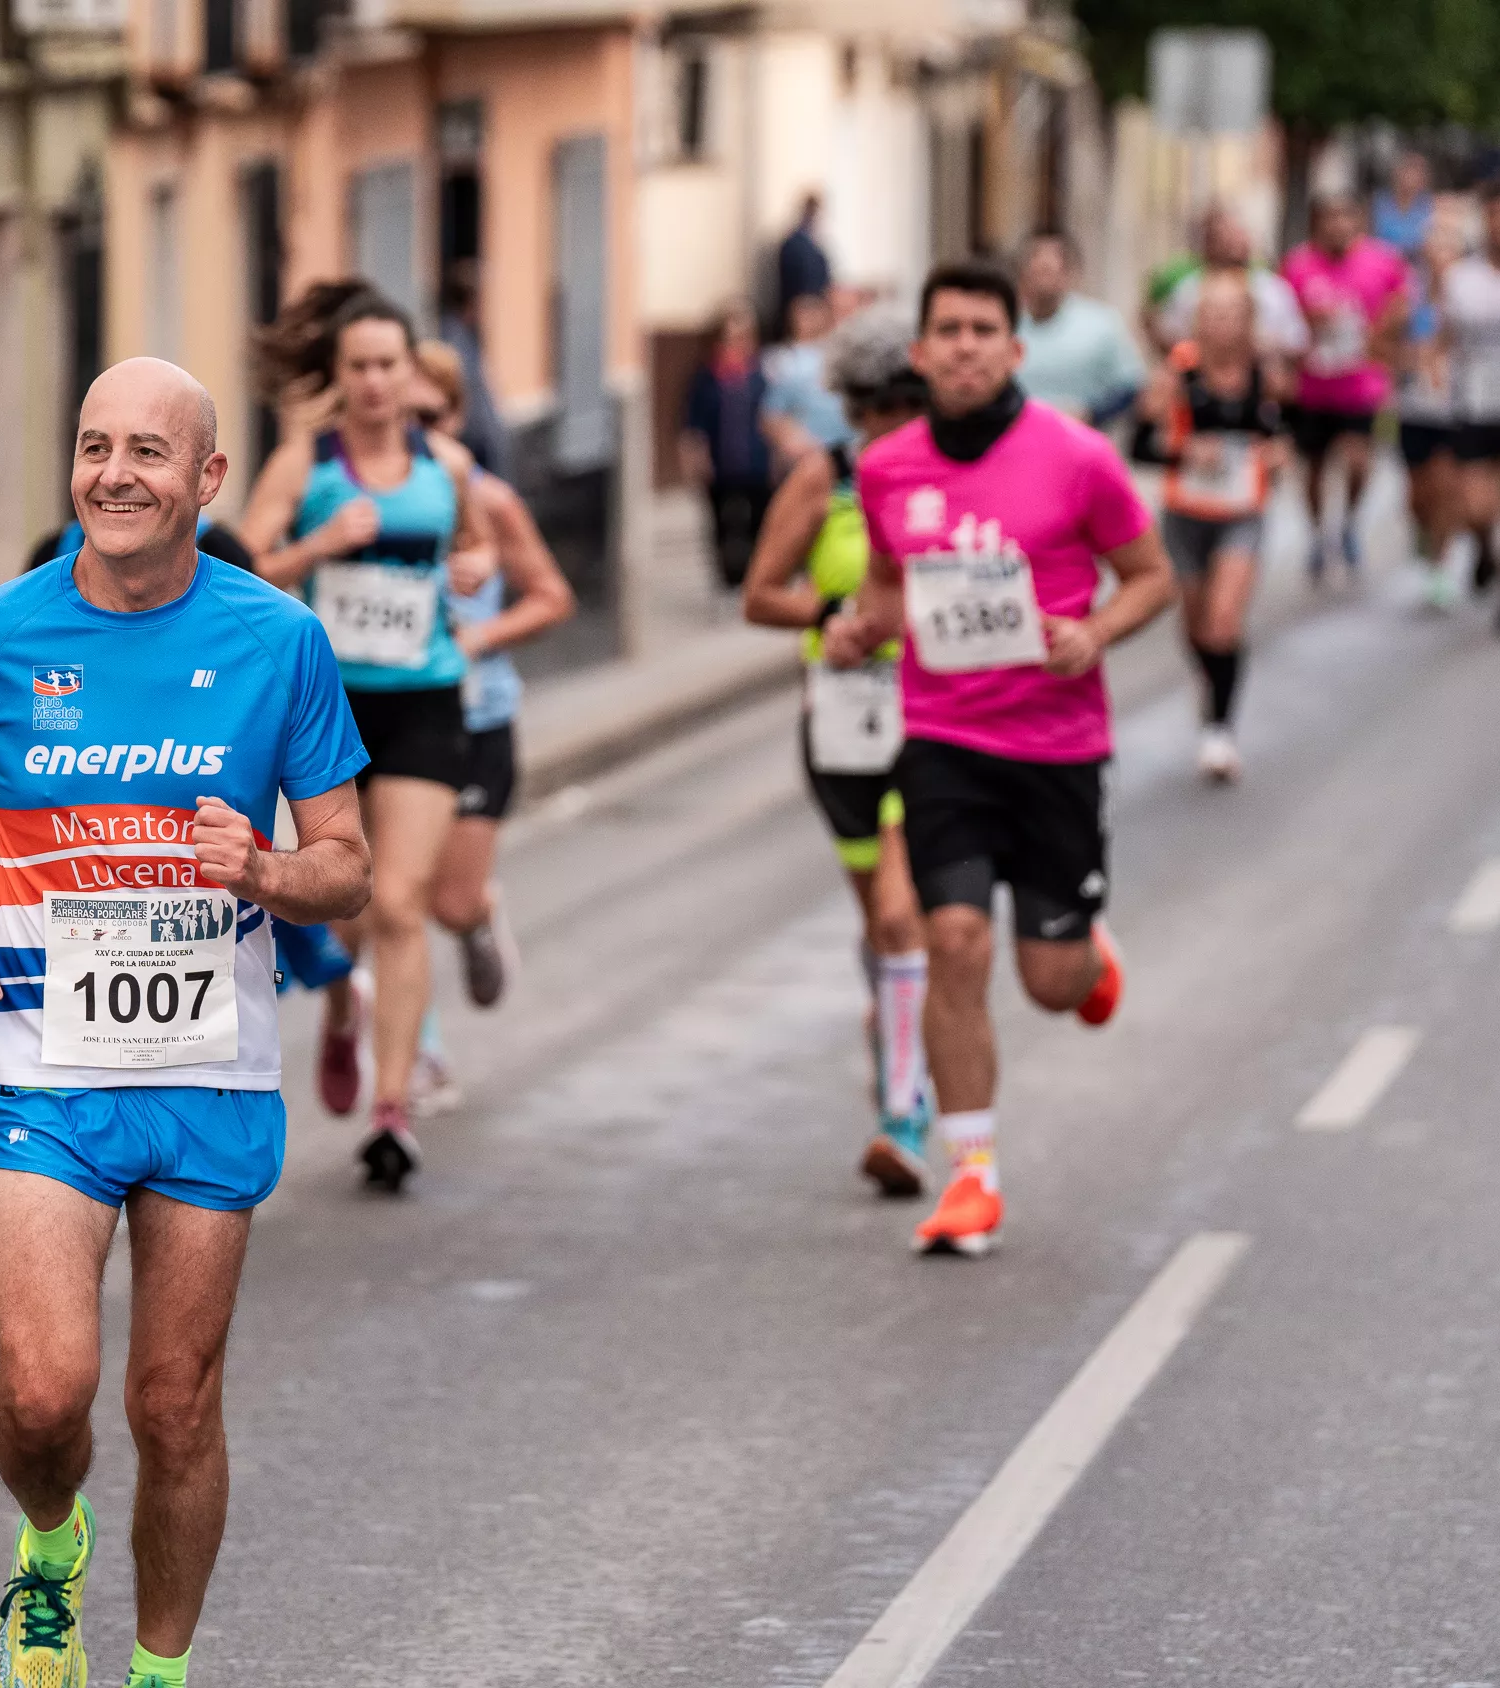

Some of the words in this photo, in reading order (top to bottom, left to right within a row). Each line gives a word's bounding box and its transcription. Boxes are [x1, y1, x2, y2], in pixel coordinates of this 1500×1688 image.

[33, 696, 62, 708] Club
[33, 706, 82, 719] Maratón
[33, 718, 79, 730] Lucena
[70, 859, 196, 889] Lucena
[51, 899, 86, 909] CIRCUITO
[87, 900, 135, 911] PROVINCIAL
[137, 901, 148, 911] DE
[150, 899, 200, 920] 2024
[50, 908, 95, 918] CARRERAS
[97, 909, 148, 919] POPULARES
[51, 917, 94, 926] DIPUTACIÓN
[111, 918, 149, 926] CÓRDOBA
[95, 949, 111, 957] XXV
[166, 949, 194, 957] LUCENA
[73, 970, 214, 1023] 1007
[161, 1034, 205, 1044] BERLANGO
